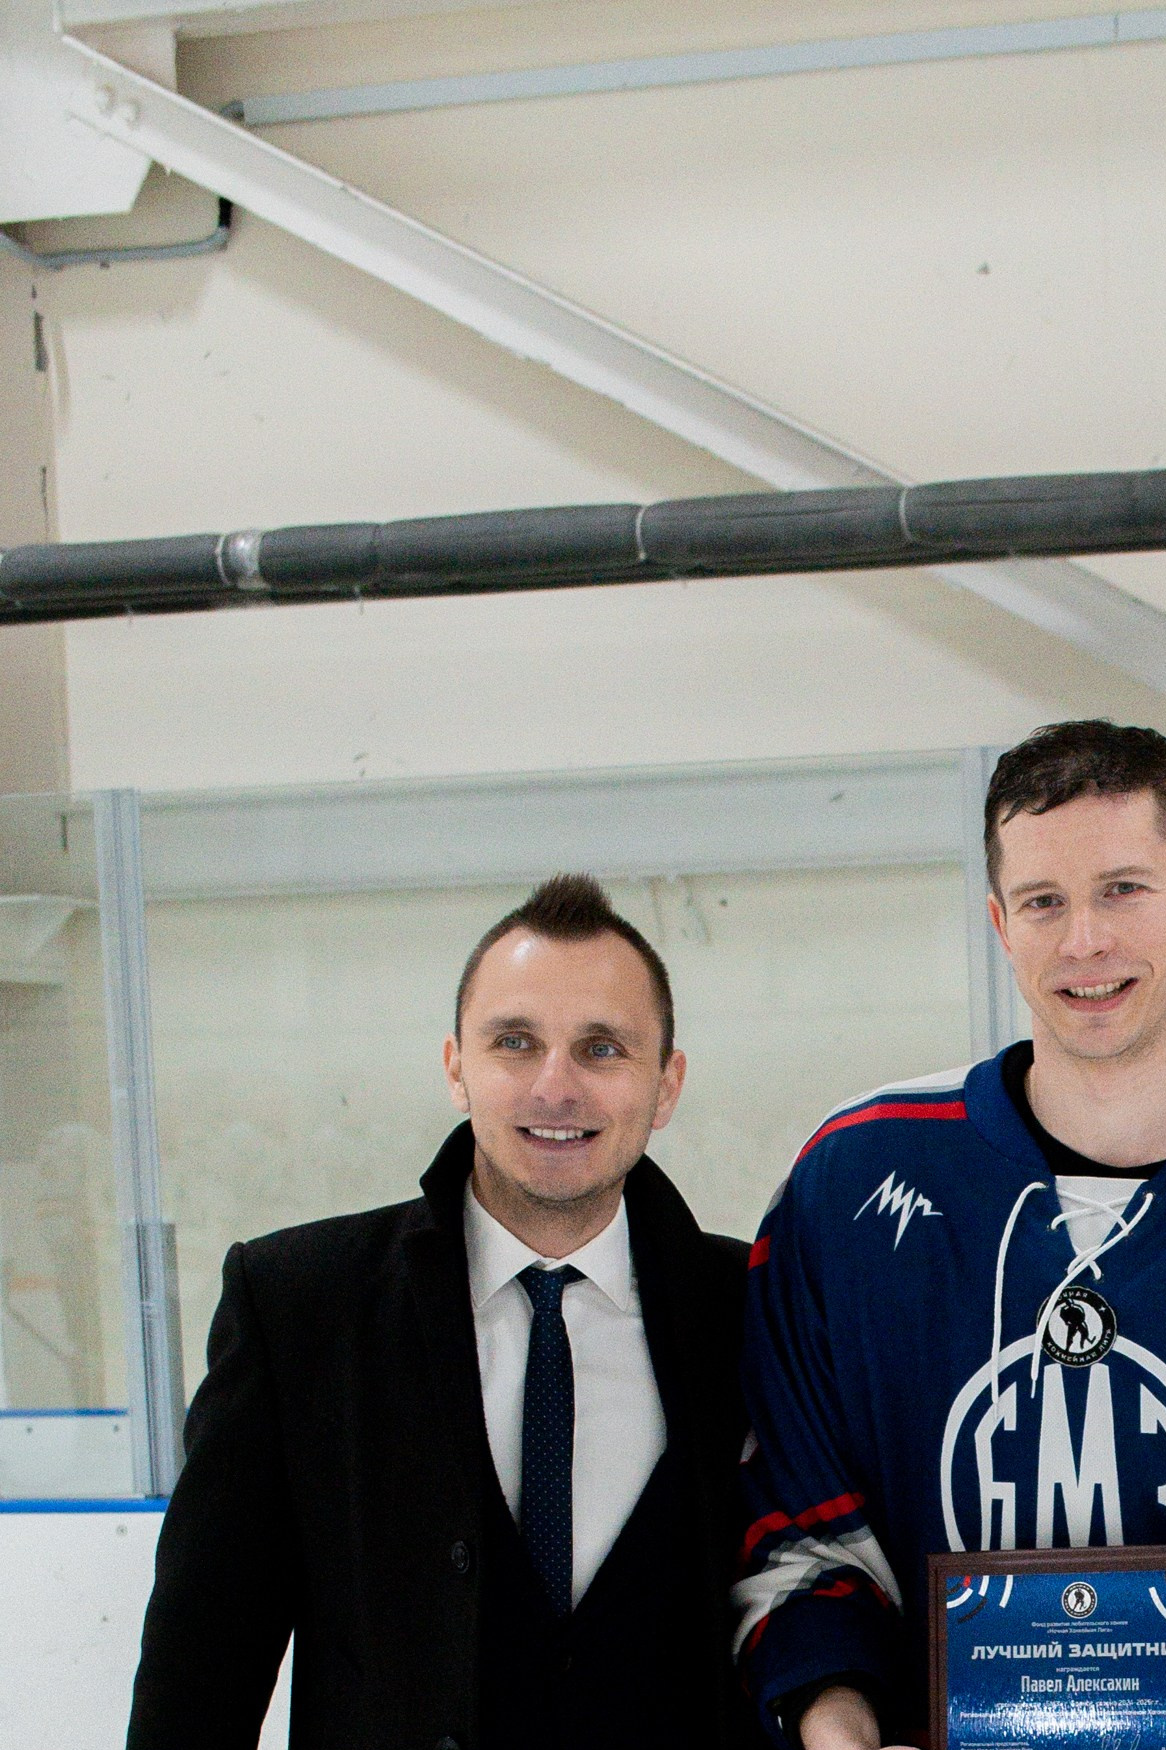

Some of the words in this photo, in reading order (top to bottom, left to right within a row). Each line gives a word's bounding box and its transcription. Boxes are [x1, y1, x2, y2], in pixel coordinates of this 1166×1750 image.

[971, 1641, 1063, 1660] ЛУЧШИЙ
[1021, 1675, 1063, 1693] Павел
[1066, 1674, 1141, 1692] Алексахин
